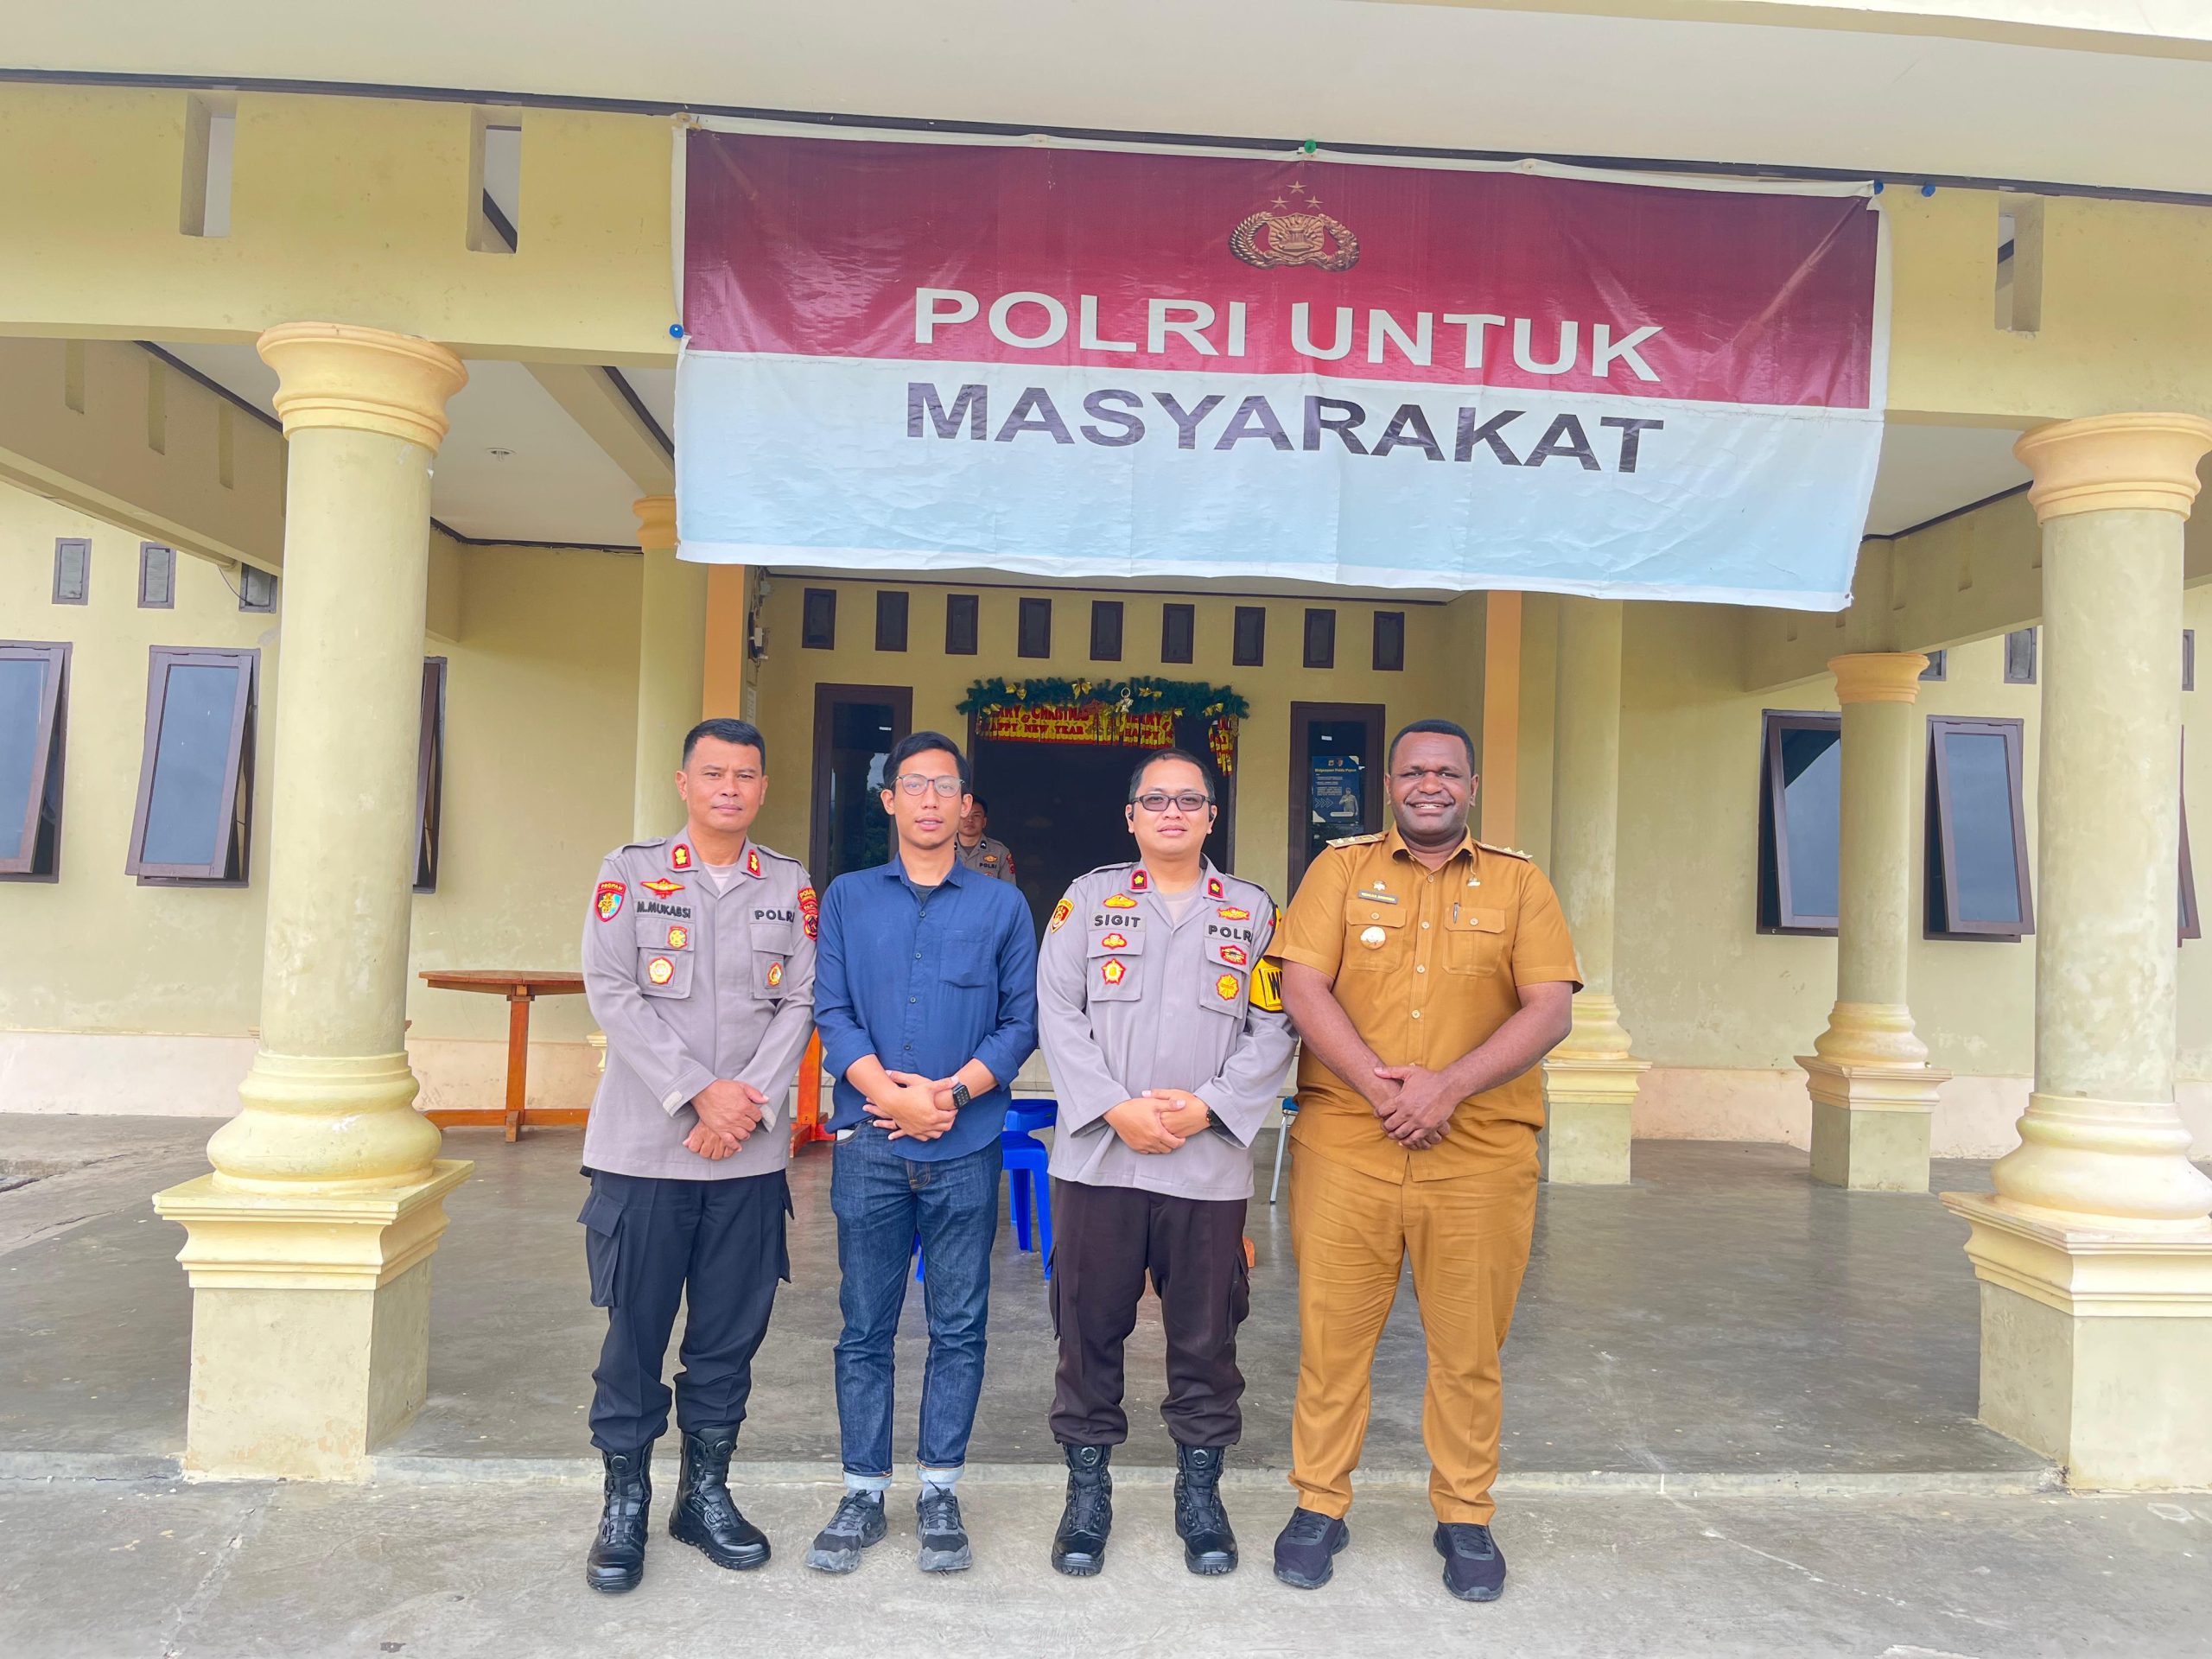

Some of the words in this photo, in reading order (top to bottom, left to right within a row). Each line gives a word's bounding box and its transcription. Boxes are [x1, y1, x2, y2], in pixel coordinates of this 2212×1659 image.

[916, 287, 1245, 356] POLRI
[1291, 302, 1663, 381] UNTUK
[906, 382, 1664, 473] MASYARAKAT
[1024, 724, 1049, 734] NEW
[1056, 726, 1084, 734] YEAR
[754, 909, 795, 923] POLRI
[1094, 914, 1141, 928] SIGIT
